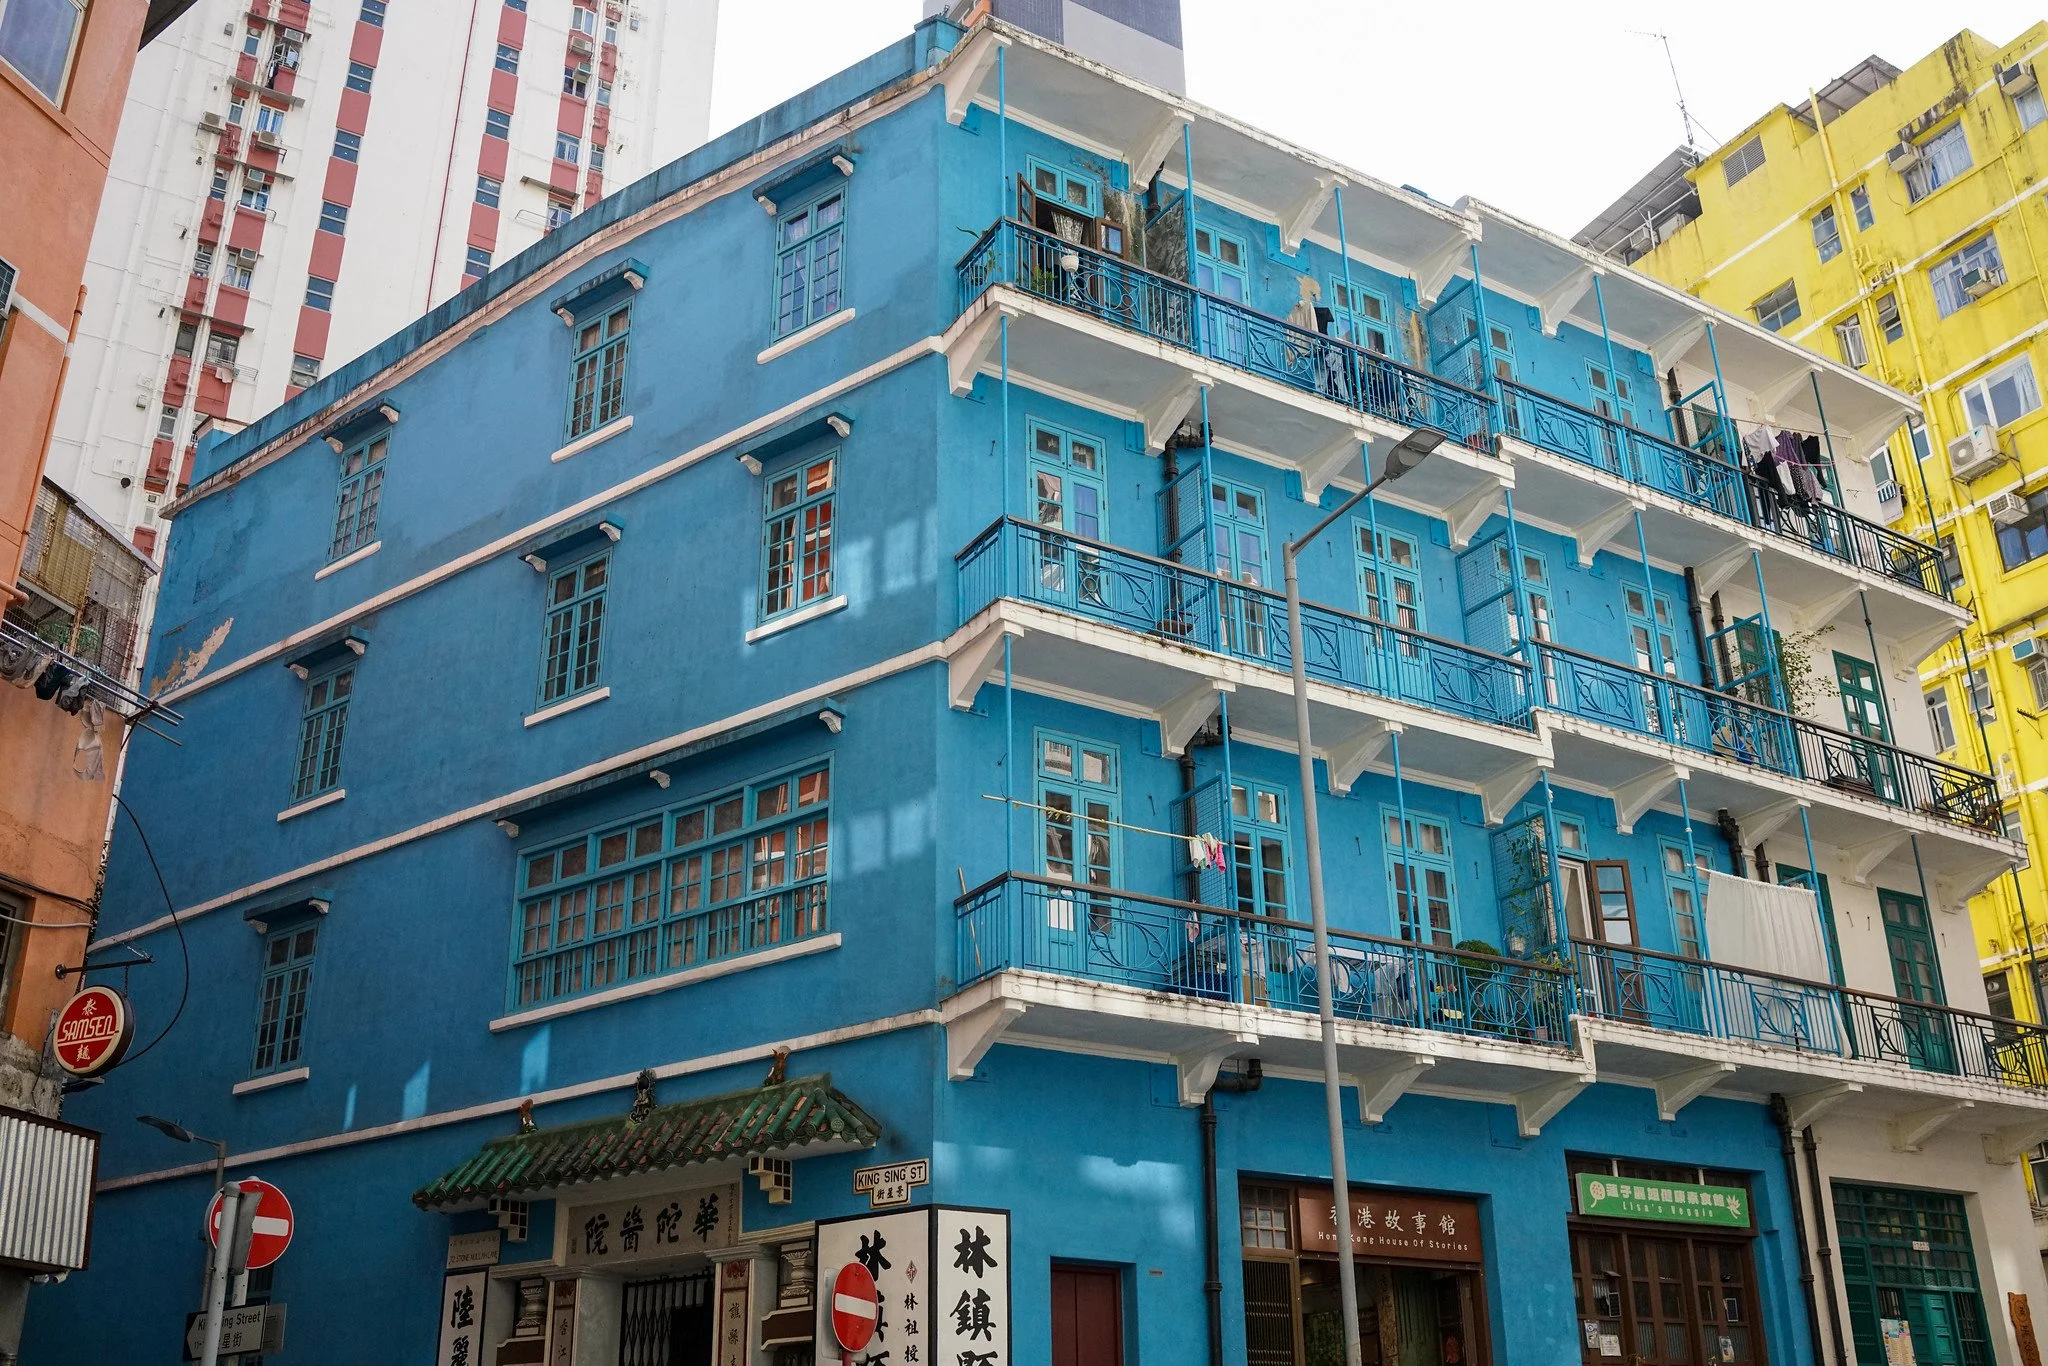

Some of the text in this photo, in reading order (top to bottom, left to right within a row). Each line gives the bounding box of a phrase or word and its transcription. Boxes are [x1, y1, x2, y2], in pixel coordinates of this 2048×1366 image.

[82, 998, 97, 1016] 泰
[58, 1015, 115, 1042] SAMSEN
[858, 1165, 923, 1187] KING SING ST
[1622, 1201, 1663, 1213] Lisa's
[1379, 1236, 1409, 1247] House
[1413, 1238, 1424, 1248] Of
[1429, 1240, 1468, 1251] Stories
[950, 1225, 998, 1366] 林鎮
[236, 1311, 261, 1325] Street
